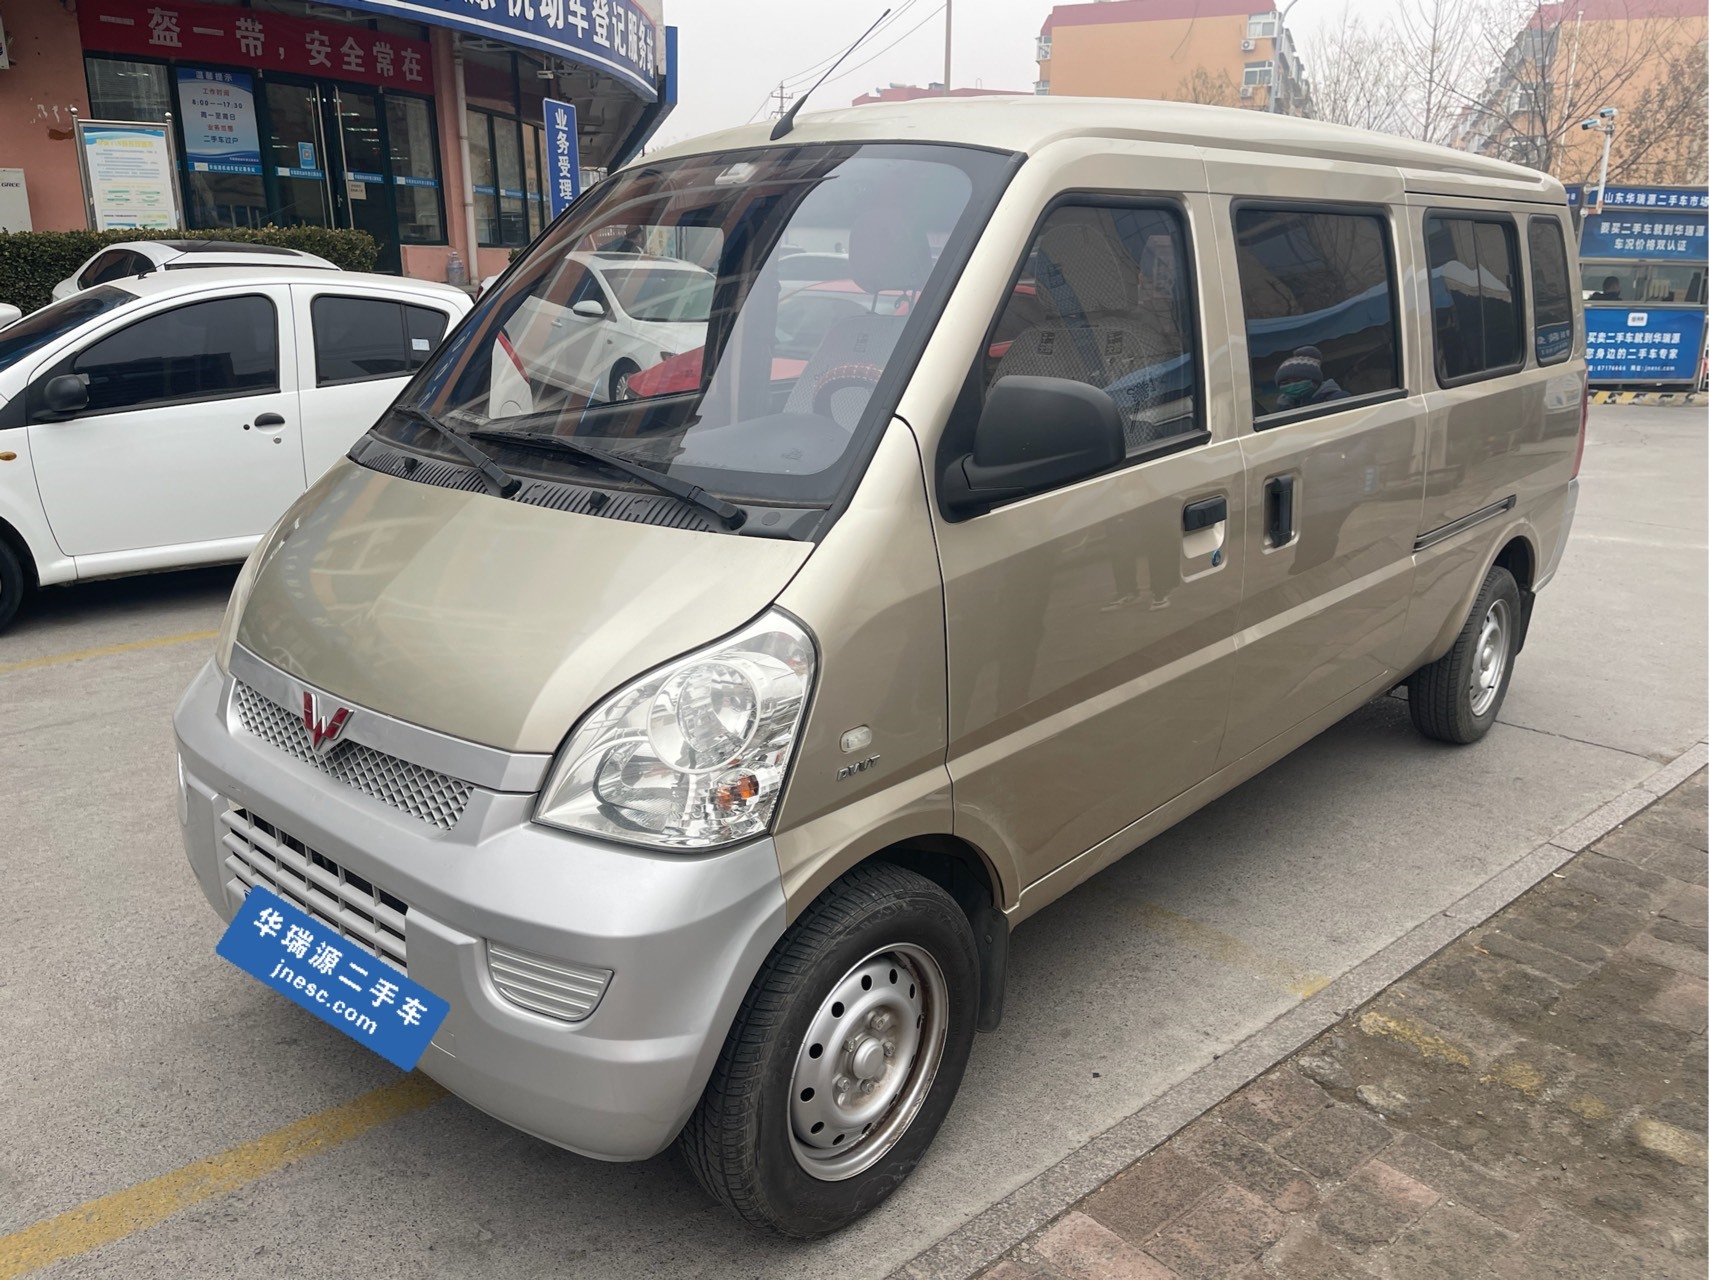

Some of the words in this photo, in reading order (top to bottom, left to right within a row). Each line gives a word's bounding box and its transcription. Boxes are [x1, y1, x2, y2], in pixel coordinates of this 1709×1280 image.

[99, 7, 423, 82] 一盔一带，安全常在
[464, 0, 654, 79] 动车登记服务站
[203, 135, 239, 144] 二手车过户
[1614, 238, 1687, 252] 车况价格双认证
[1587, 332, 1681, 344] 买卖二手车就到华瑞源
[1584, 348, 1679, 360] 您身边的二手车专家
